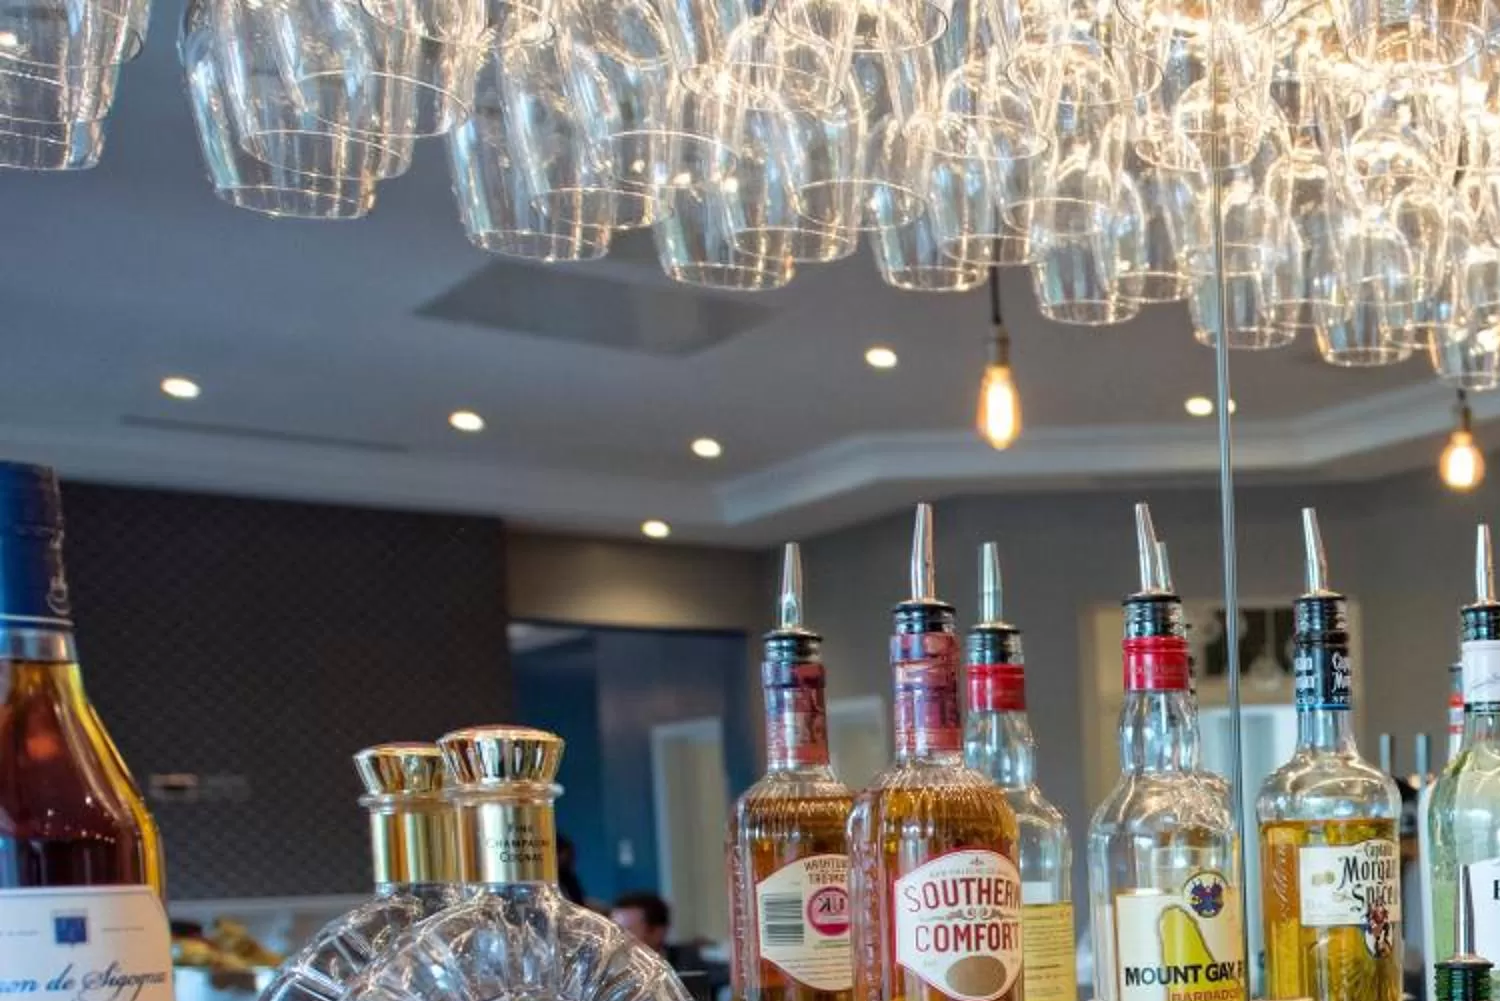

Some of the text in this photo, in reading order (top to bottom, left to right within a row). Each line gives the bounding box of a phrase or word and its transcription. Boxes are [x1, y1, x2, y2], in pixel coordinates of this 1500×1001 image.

[915, 921, 1019, 953] COMFORT
[46, 963, 75, 991] de
[1124, 964, 1202, 987] MOUNT
[1205, 962, 1235, 983] GAY
